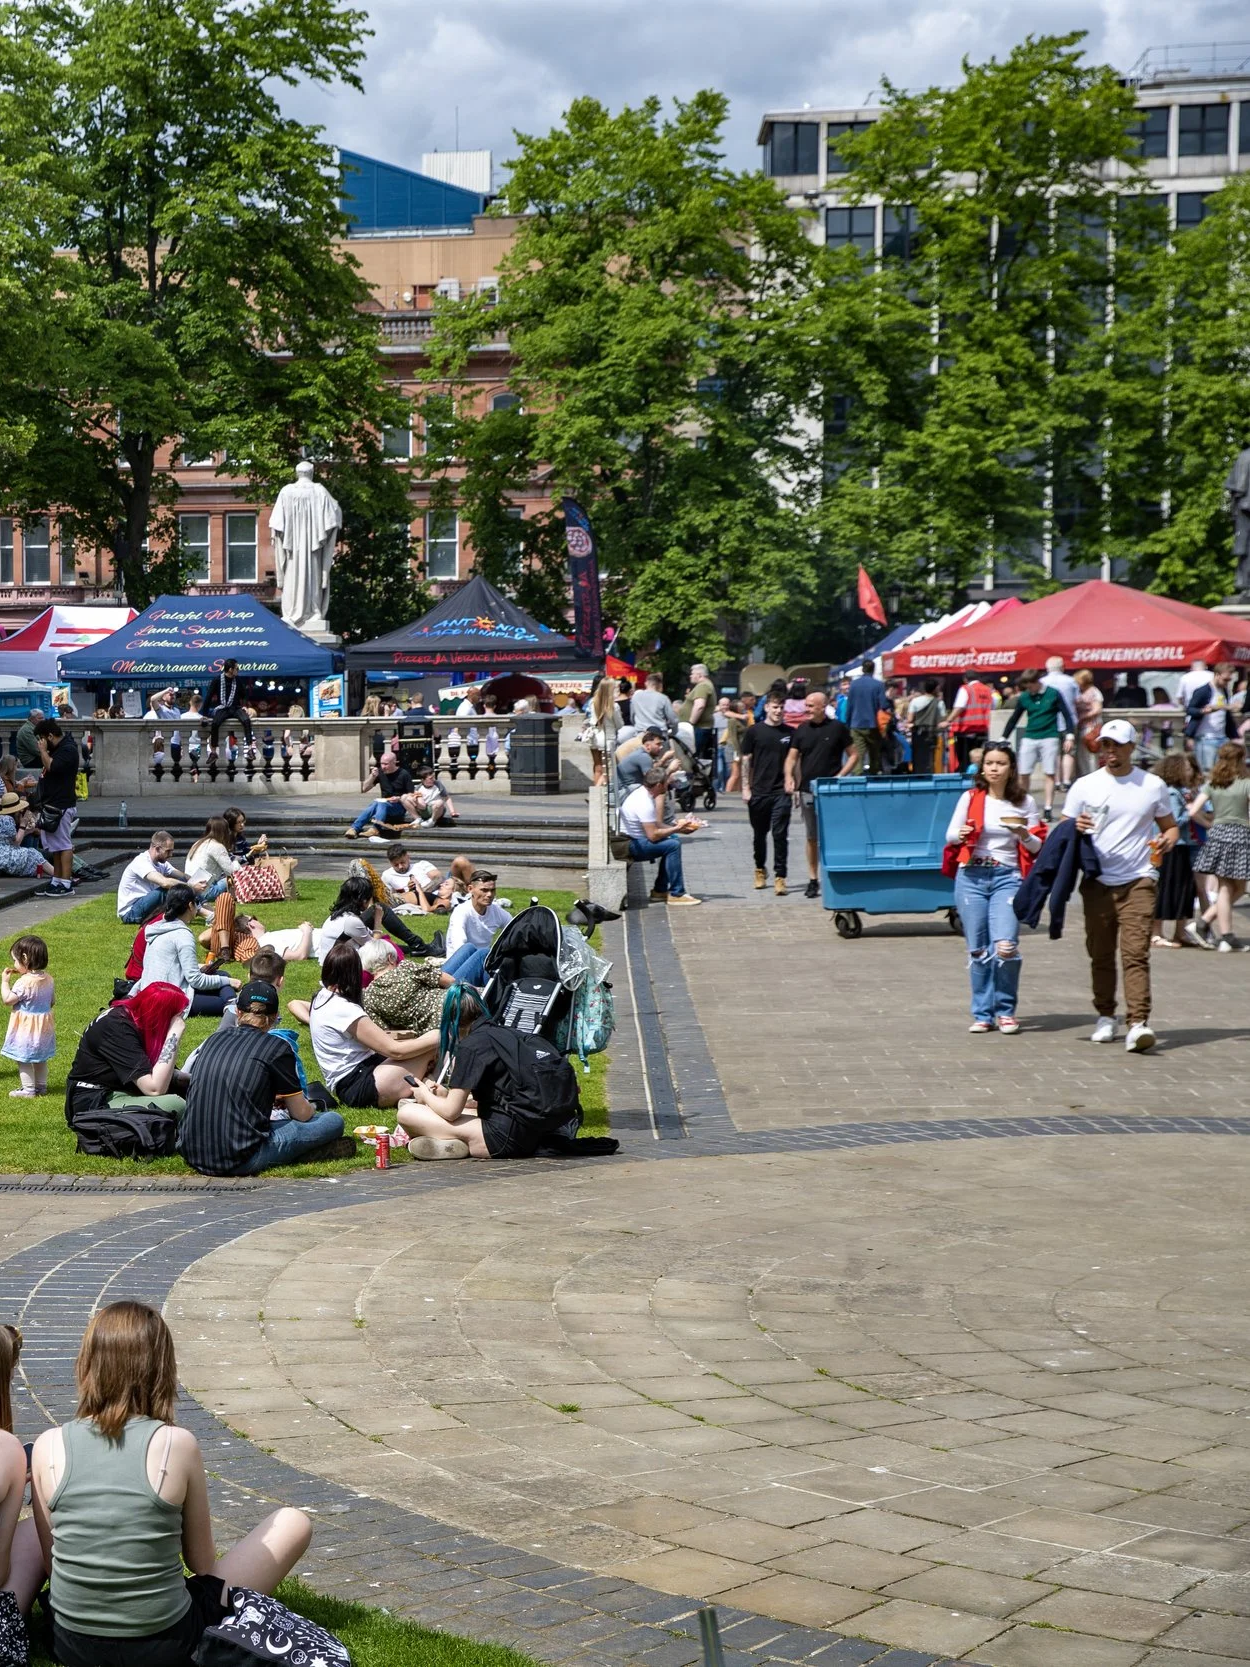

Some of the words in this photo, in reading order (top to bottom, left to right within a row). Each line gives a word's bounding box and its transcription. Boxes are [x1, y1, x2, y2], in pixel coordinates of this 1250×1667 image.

[149, 609, 202, 622] Falafel
[204, 609, 254, 620] Wrap
[134, 624, 180, 637] Lamb
[181, 624, 265, 636] Shawarma
[409, 628, 462, 638] MADE
[464, 627, 476, 635] IN
[478, 630, 539, 642] NAPLES
[126, 638, 184, 650] Chicken
[185, 638, 269, 650] Shawarma
[451, 652, 490, 664] VERACE
[493, 650, 559, 663] NAPOLETANA
[910, 651, 1018, 668] BRATWURST-STEAKS
[1072, 646, 1186, 662] SCHWENKGRILL
[112, 659, 207, 674] Mediterranean
[208, 658, 279, 673] Swarma
[184, 678, 213, 688] Shaw
